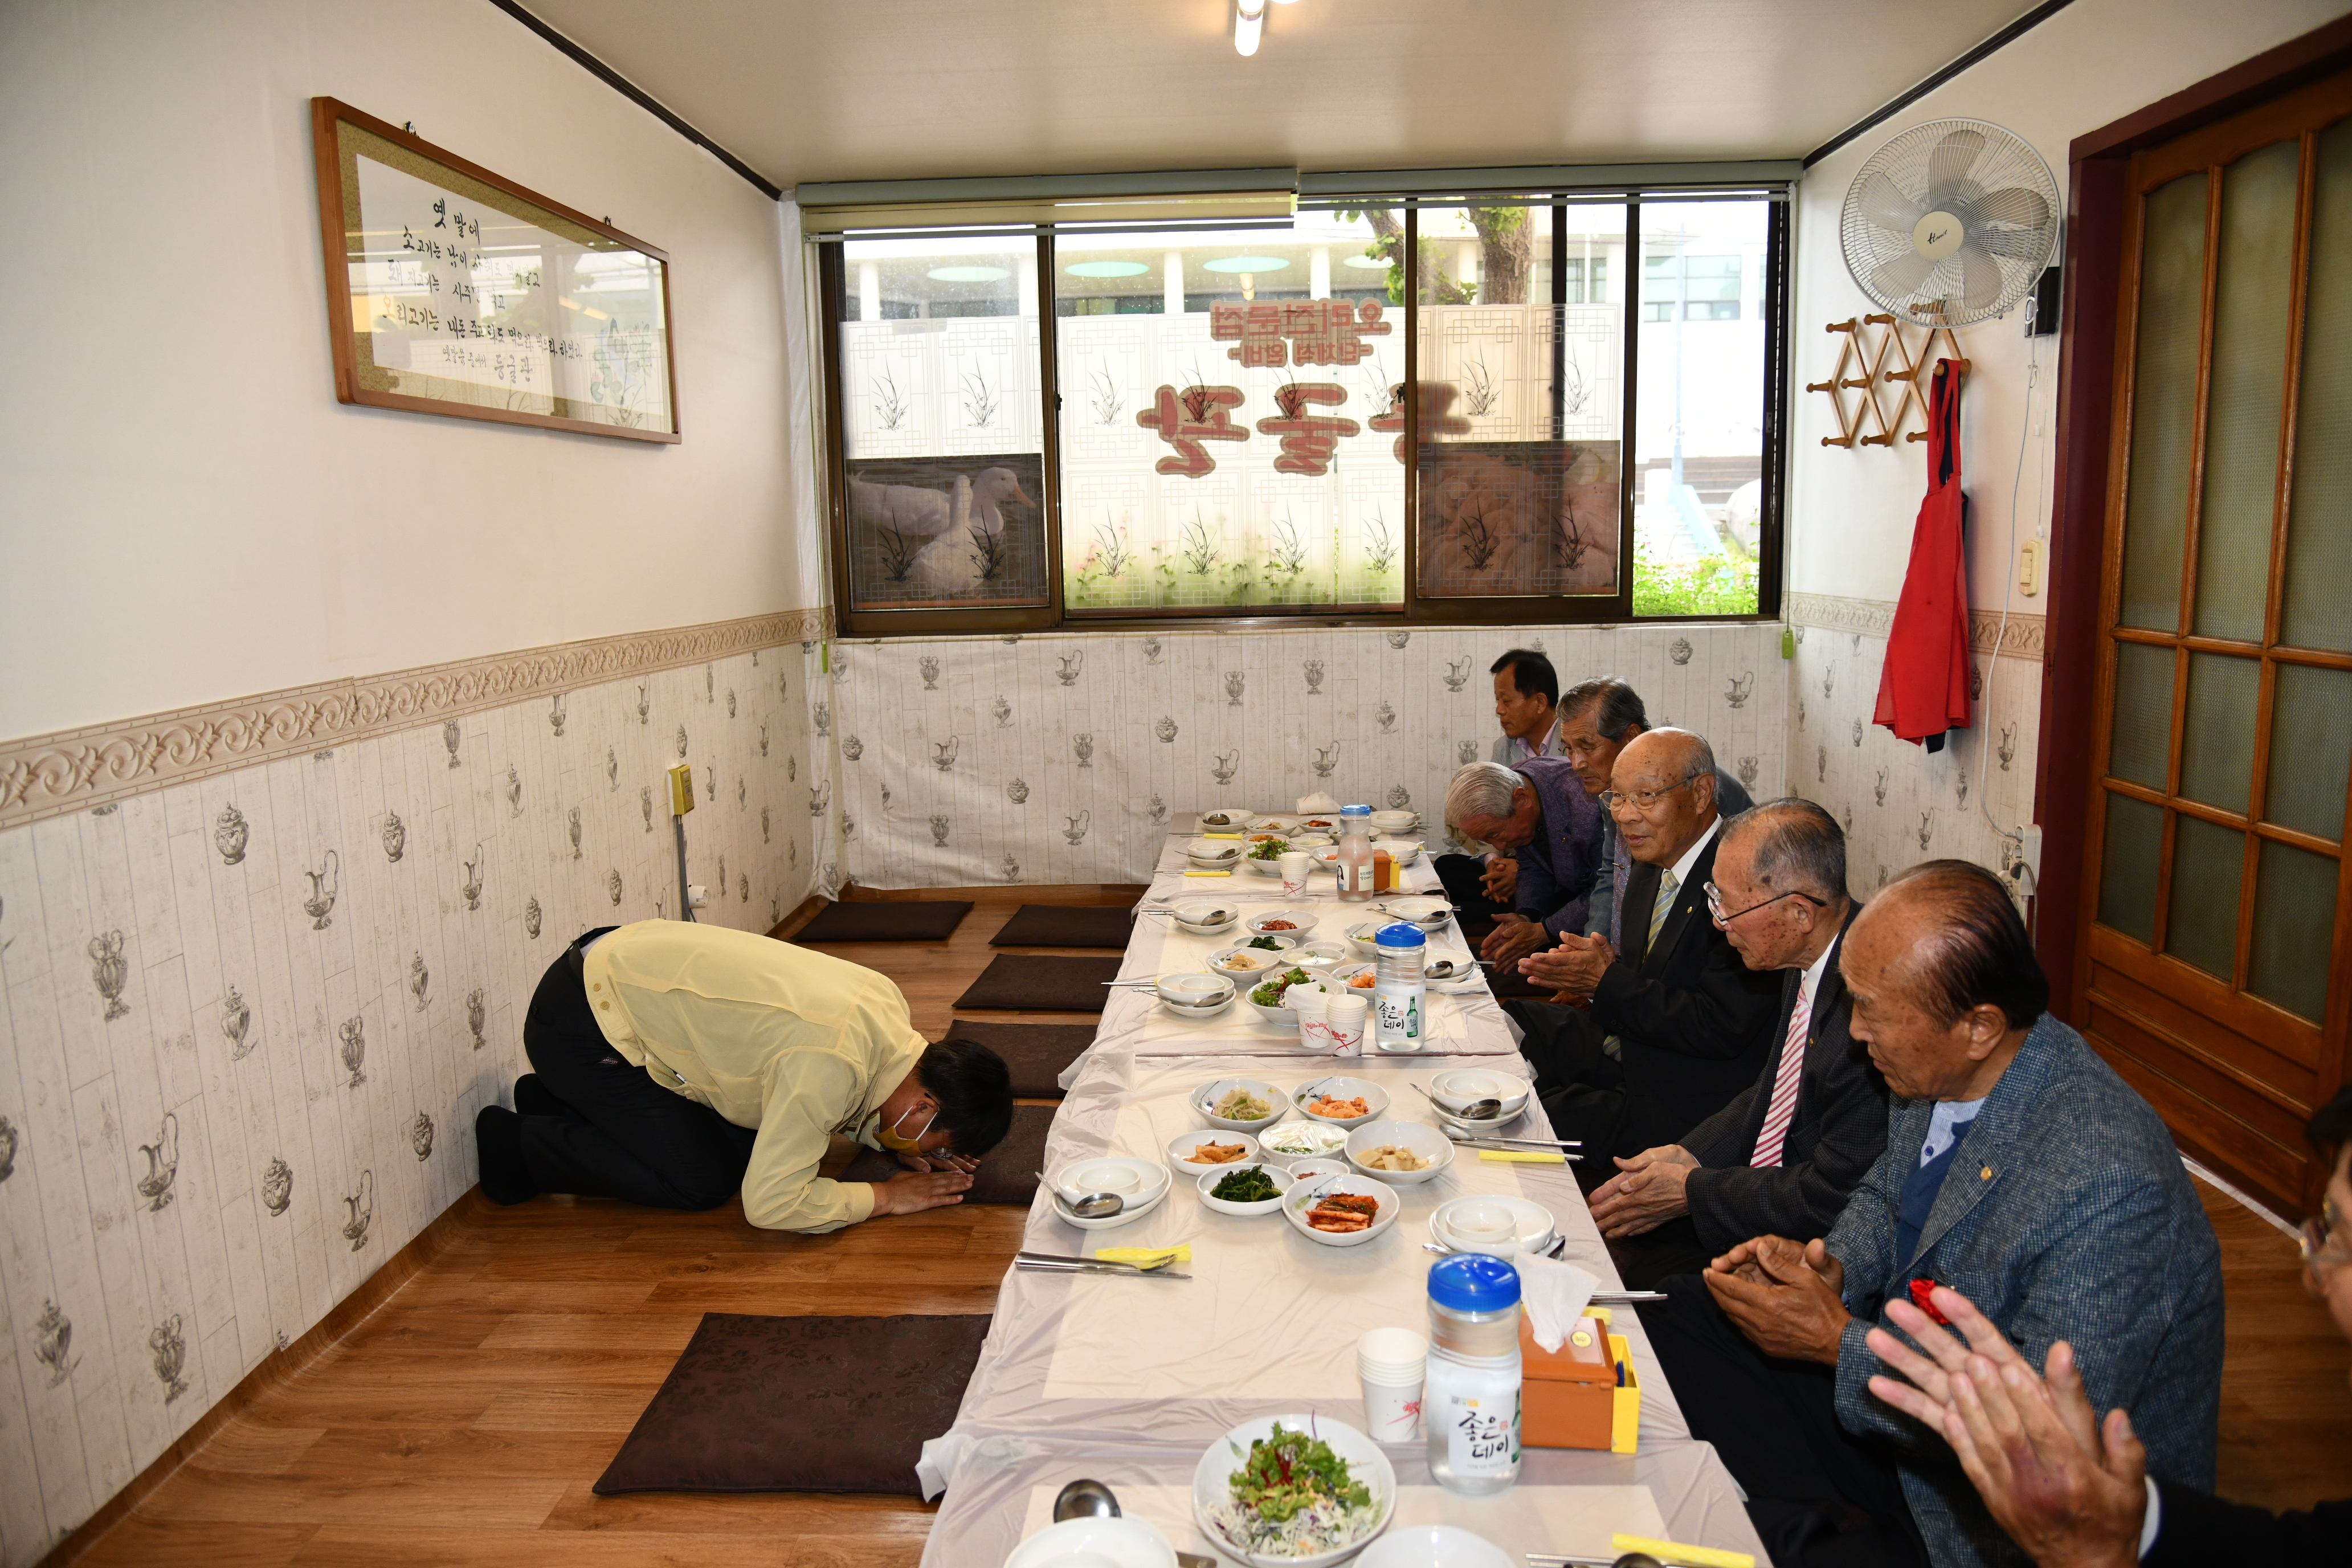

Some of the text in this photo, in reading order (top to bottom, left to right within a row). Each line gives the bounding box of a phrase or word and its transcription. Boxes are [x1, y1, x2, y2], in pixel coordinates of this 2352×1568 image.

[447, 244, 467, 270] 남이
[382, 295, 439, 331] 오리고기는
[1378, 1001, 1399, 1019] 좋은
[1383, 1018, 1404, 1030] 데이
[1458, 1410, 1501, 1442] 좋은
[1471, 1434, 1509, 1460] 데이
